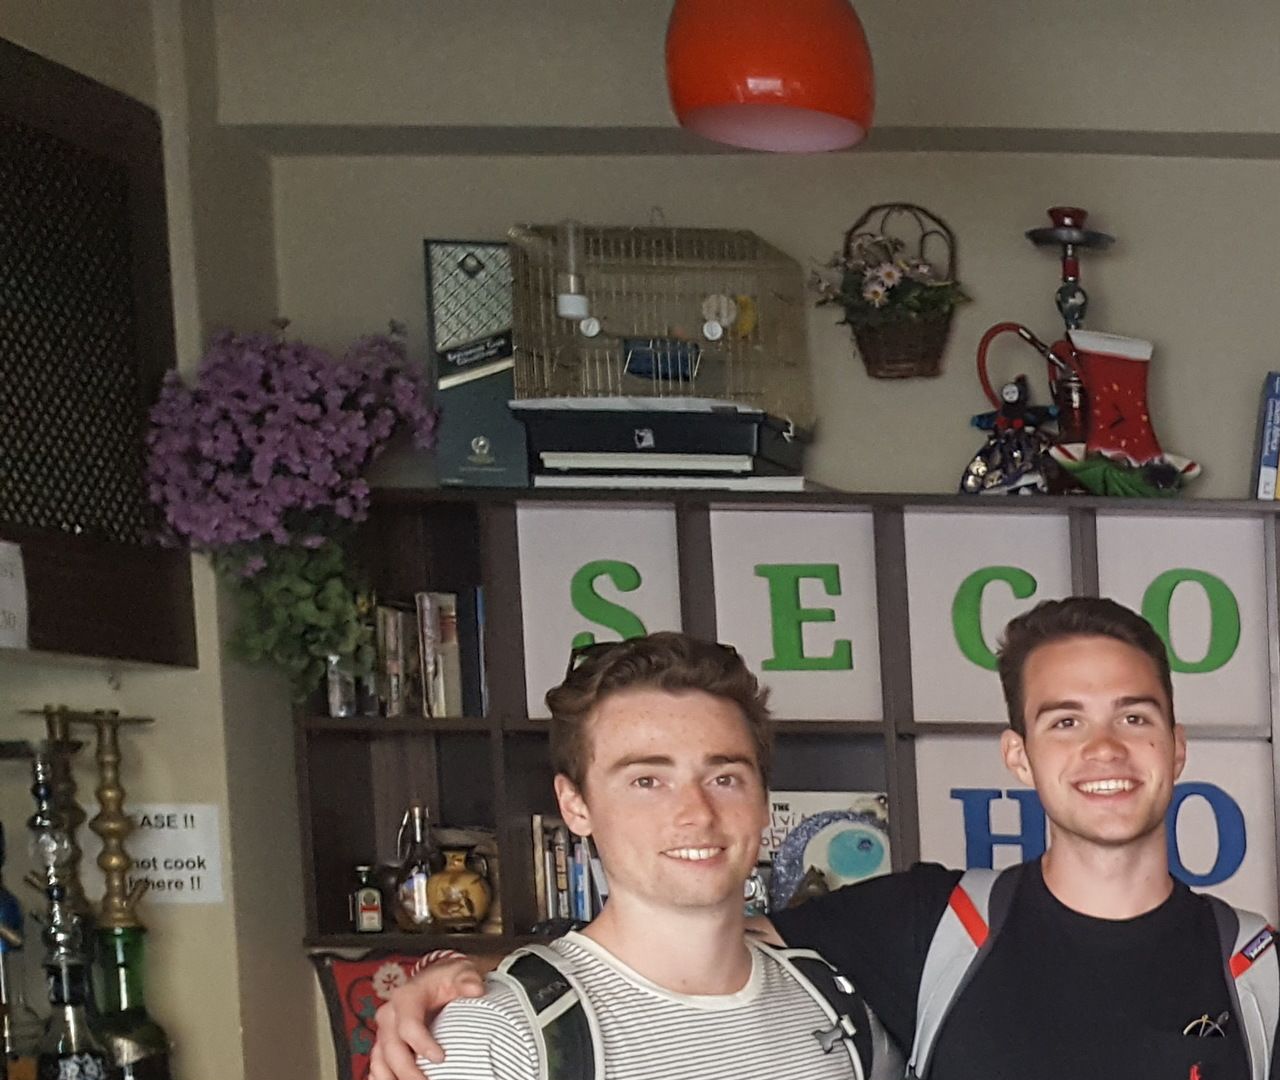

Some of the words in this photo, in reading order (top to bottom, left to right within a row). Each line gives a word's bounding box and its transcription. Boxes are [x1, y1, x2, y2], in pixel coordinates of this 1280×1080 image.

[772, 803, 790, 811] THE
[139, 813, 178, 829] ASE
[163, 855, 207, 870] cook
